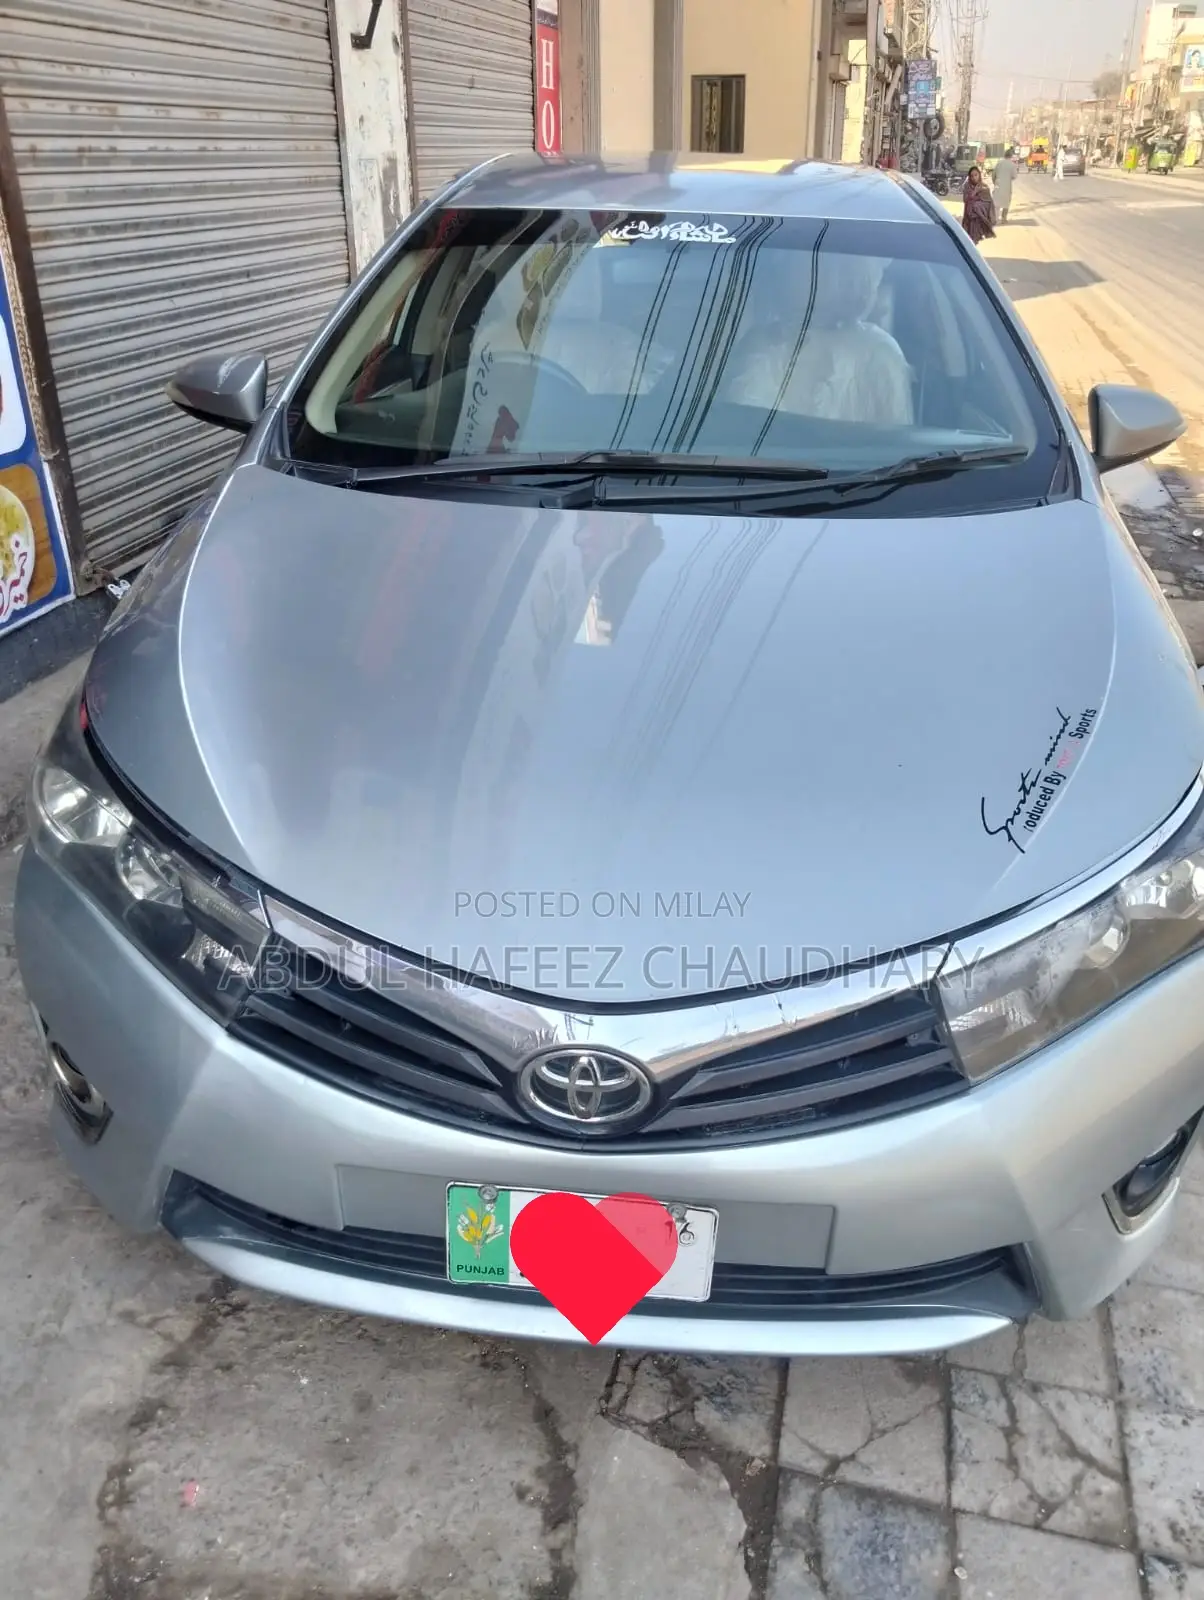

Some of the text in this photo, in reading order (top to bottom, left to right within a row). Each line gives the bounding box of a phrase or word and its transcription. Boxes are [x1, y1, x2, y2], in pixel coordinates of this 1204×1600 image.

[1043, 770, 1067, 787] By
[1068, 708, 1098, 740] Sports
[456, 1264, 505, 1276] PUNJAB
